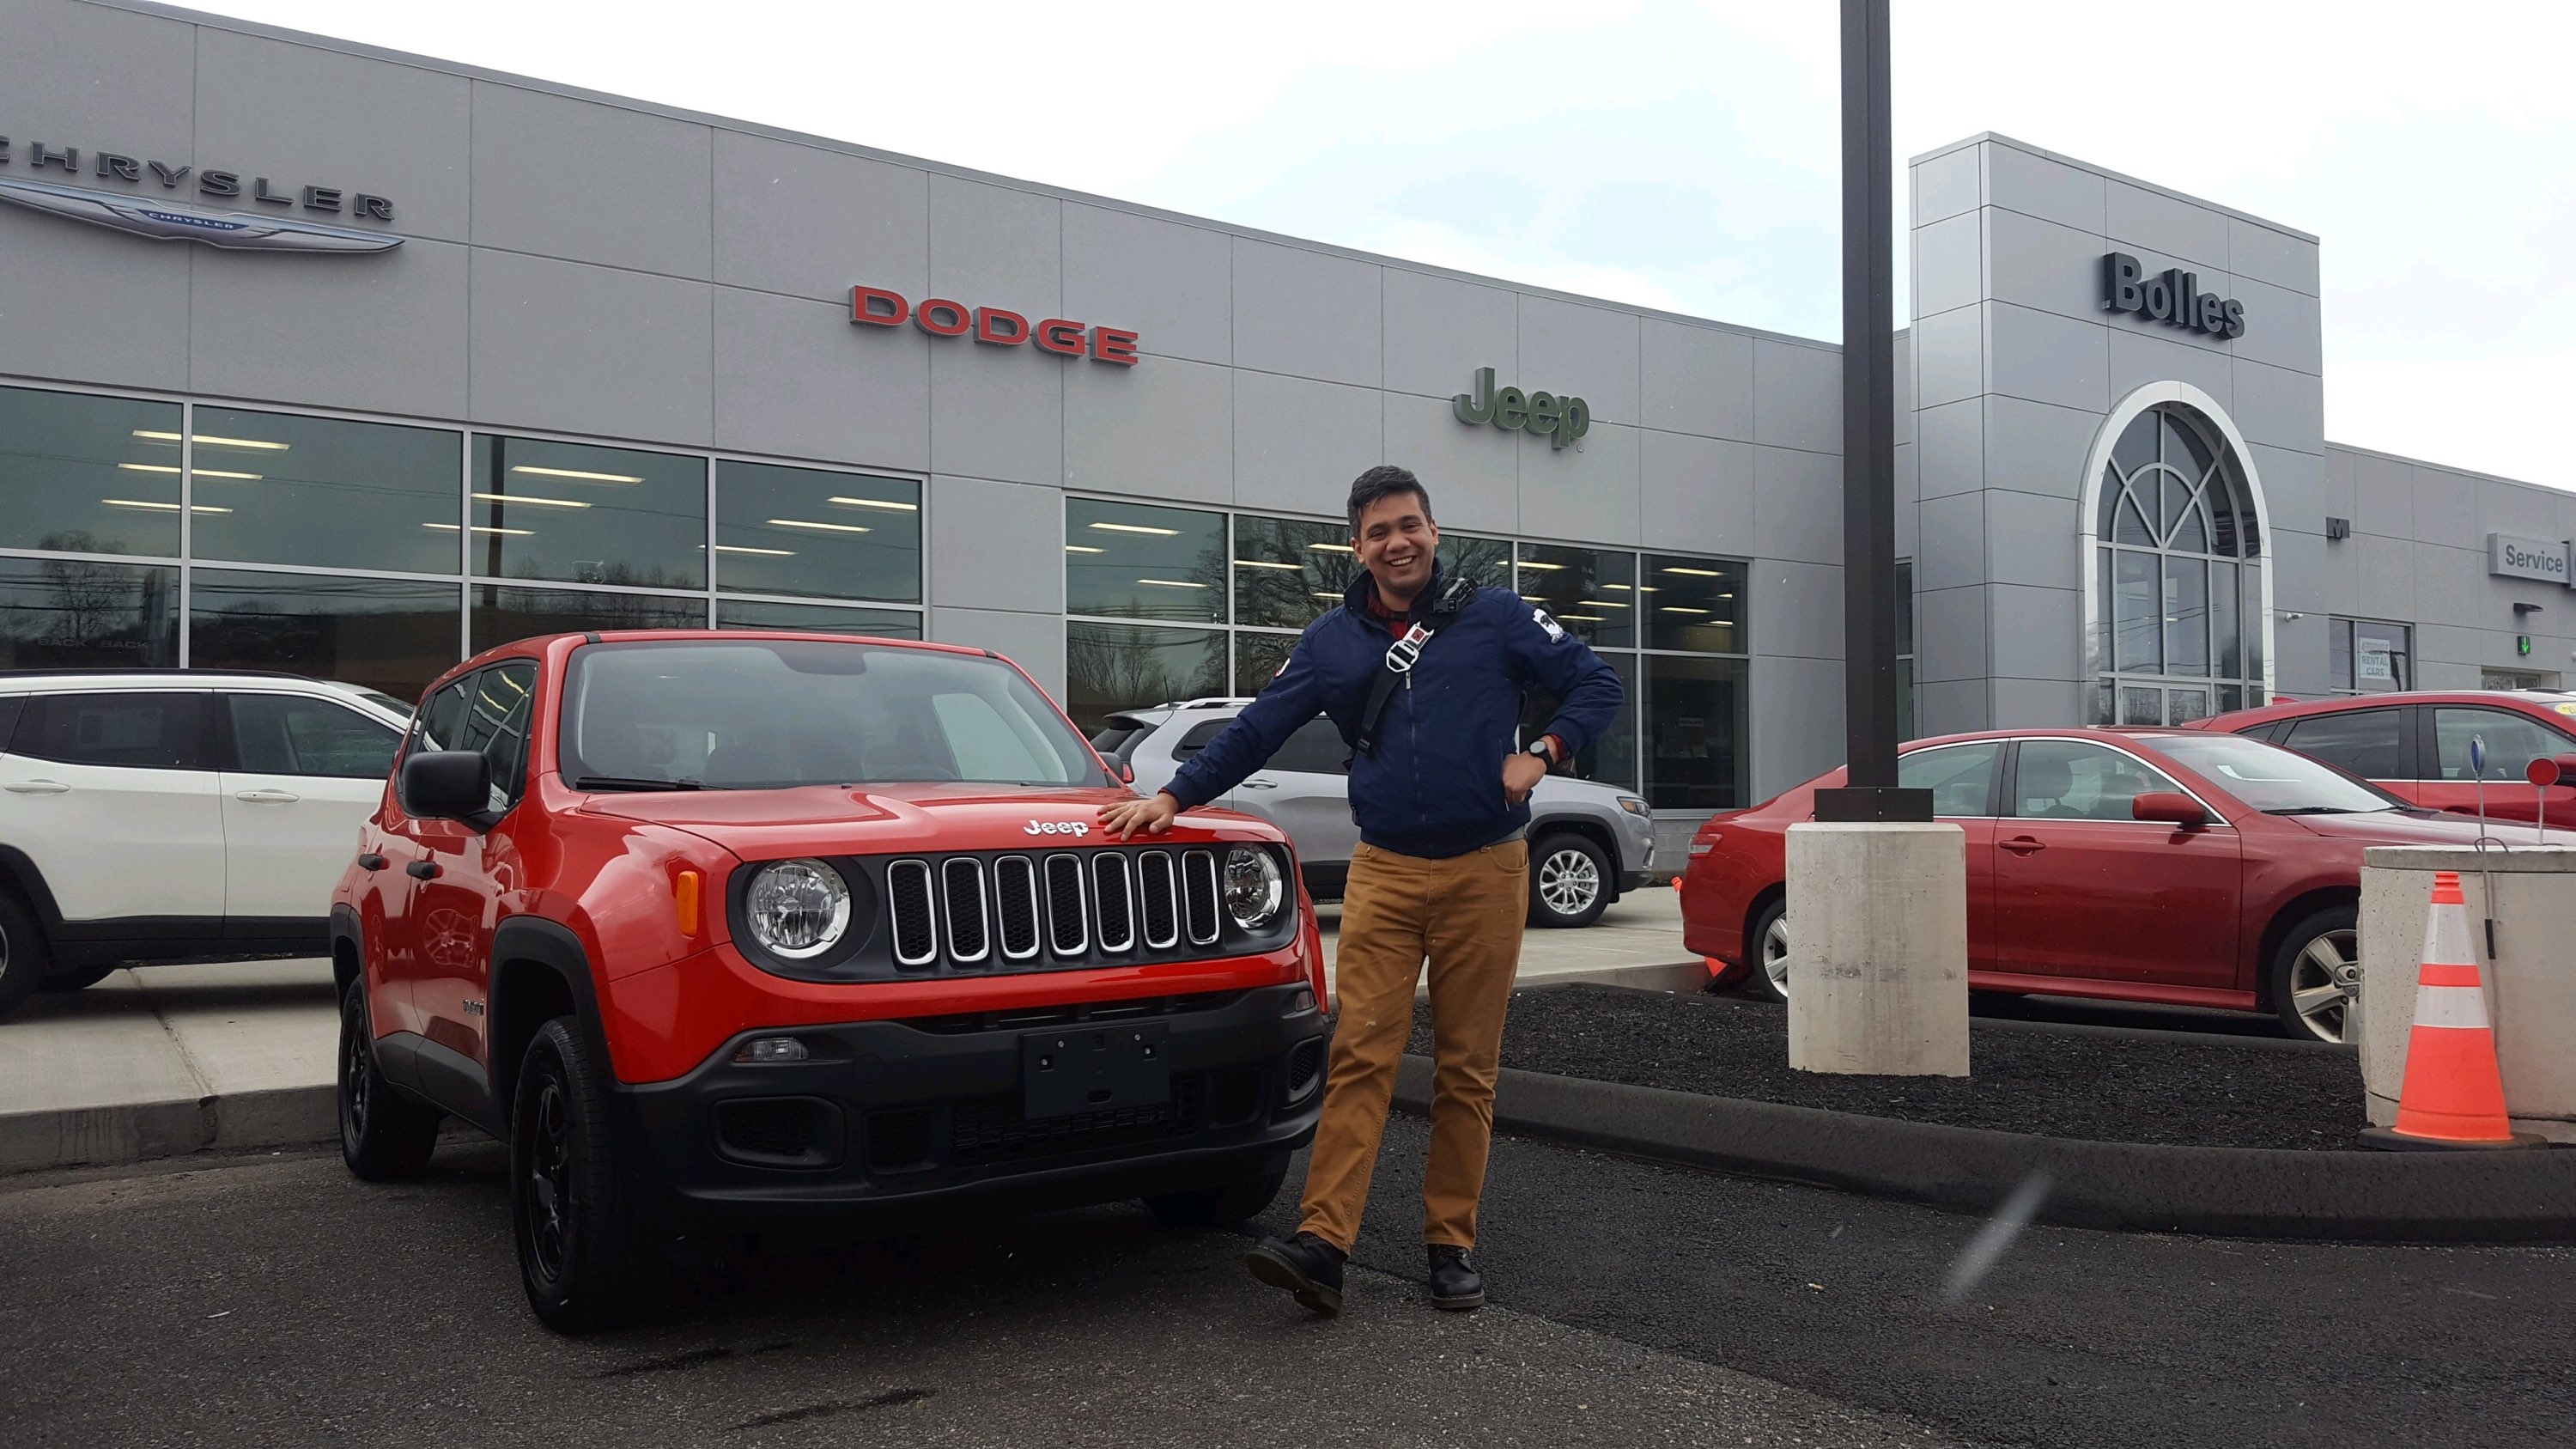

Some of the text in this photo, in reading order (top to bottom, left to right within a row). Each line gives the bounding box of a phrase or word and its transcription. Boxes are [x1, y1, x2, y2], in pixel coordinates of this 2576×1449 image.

[0, 135, 395, 220] HRYSLER
[148, 212, 234, 229] CHRYSLER
[2103, 252, 2245, 339] Bolles
[849, 285, 1139, 367] DODGE
[1453, 367, 1590, 449] Jeep
[2506, 544, 2563, 573] Service
[100, 639, 151, 649] BACK
[2361, 655, 2389, 666] RENTAL
[2366, 667, 2385, 676] CARS
[1023, 819, 1089, 837] Jeep
